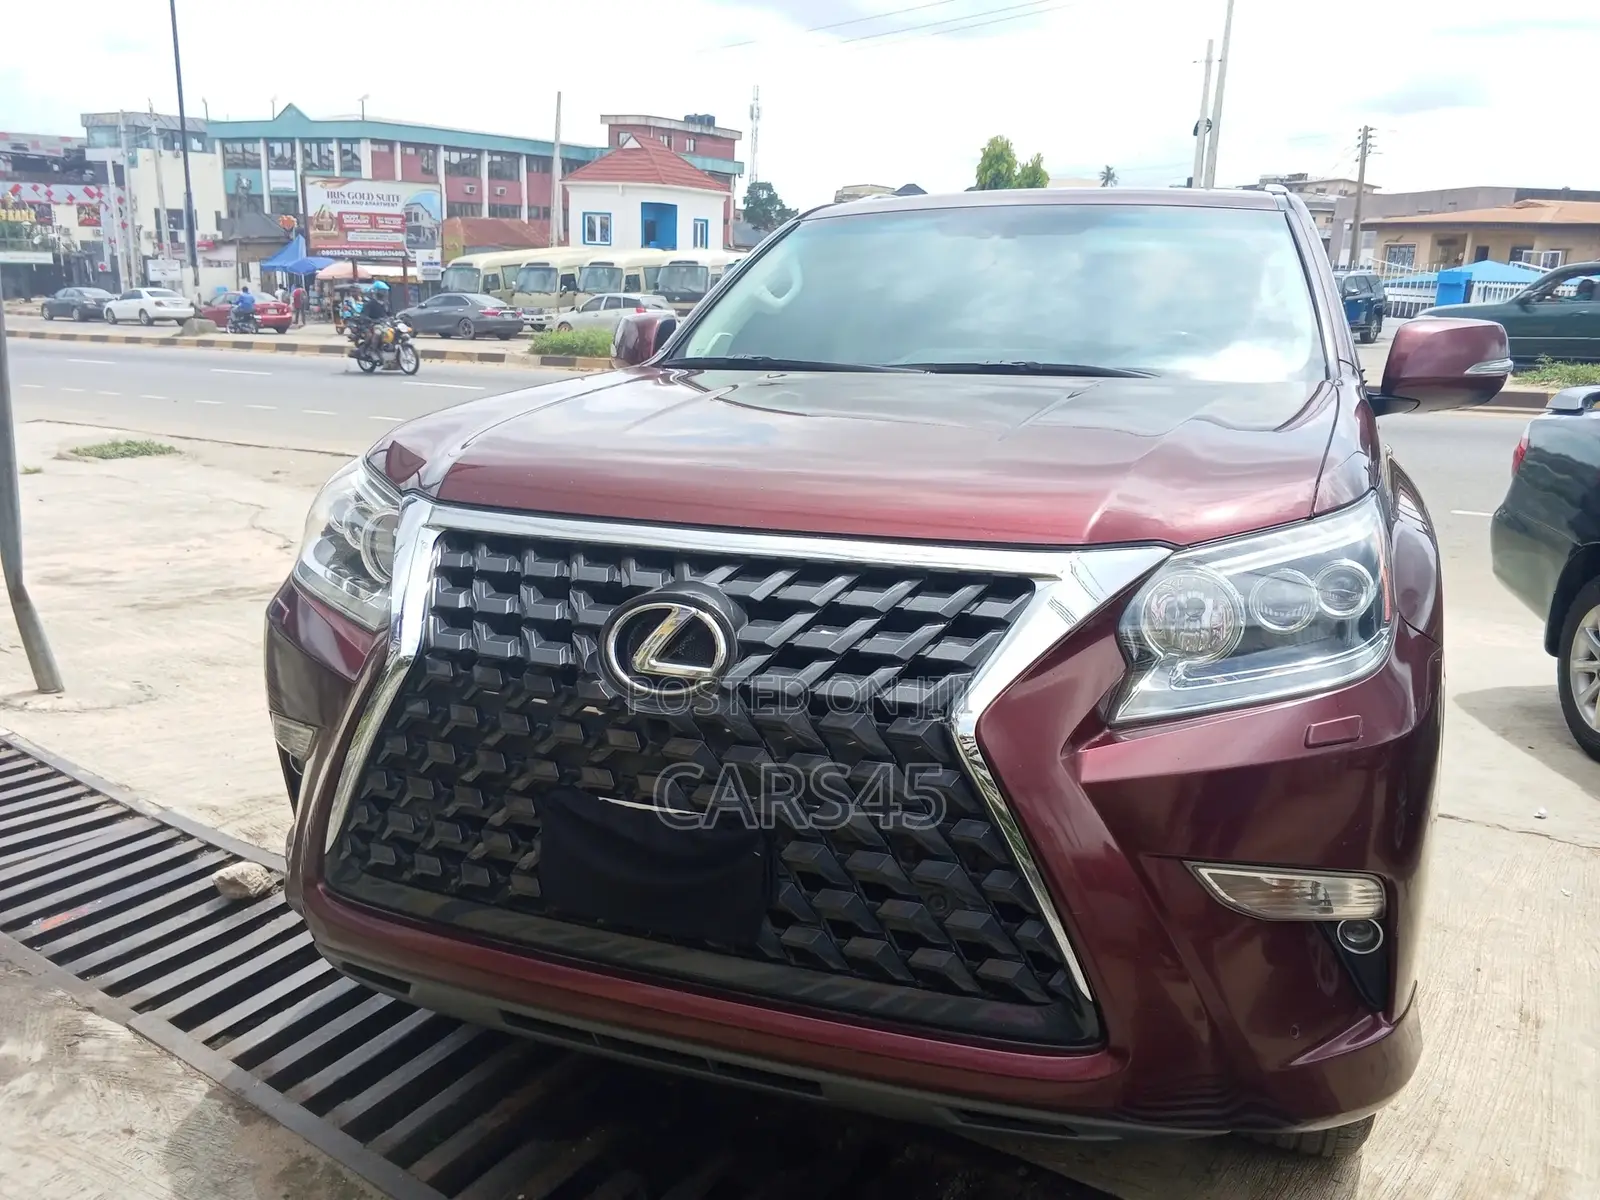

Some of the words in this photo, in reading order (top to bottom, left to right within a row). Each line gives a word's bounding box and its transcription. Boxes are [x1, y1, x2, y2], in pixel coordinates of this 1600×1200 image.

[326, 190, 346, 199] IRIS
[347, 191, 374, 201] GOLD
[376, 193, 402, 203] SUITE
